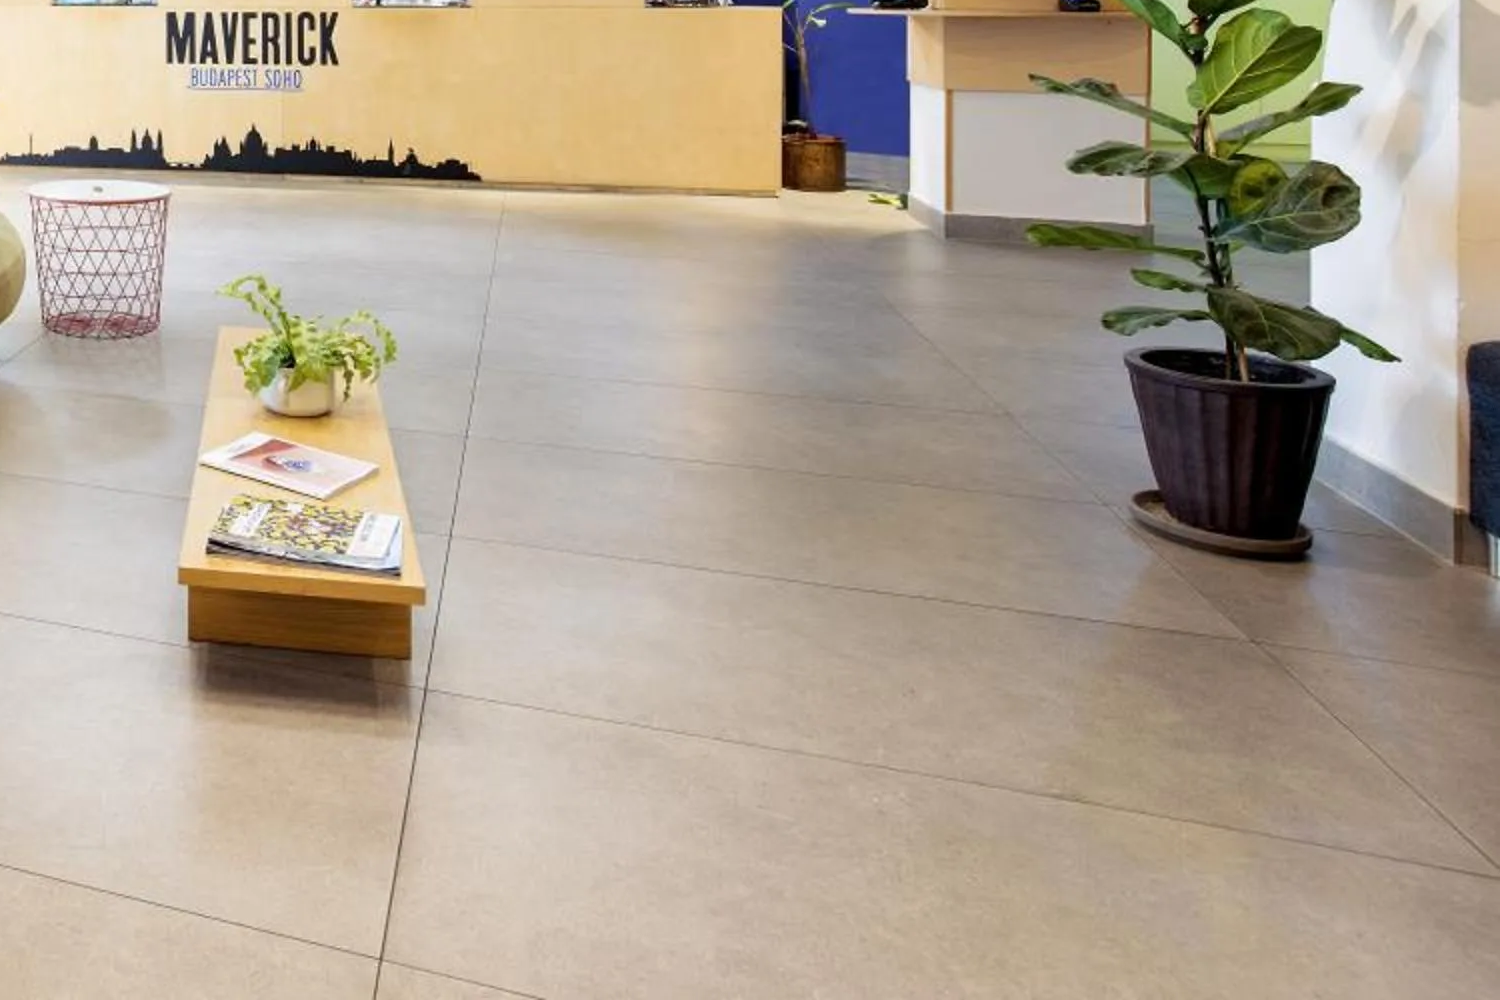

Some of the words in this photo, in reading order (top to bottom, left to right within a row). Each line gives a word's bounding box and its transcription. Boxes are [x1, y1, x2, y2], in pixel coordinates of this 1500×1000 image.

[166, 11, 339, 66] MAVERICK
[190, 67, 258, 88] BUDAPEST
[264, 69, 303, 89] SOHO
